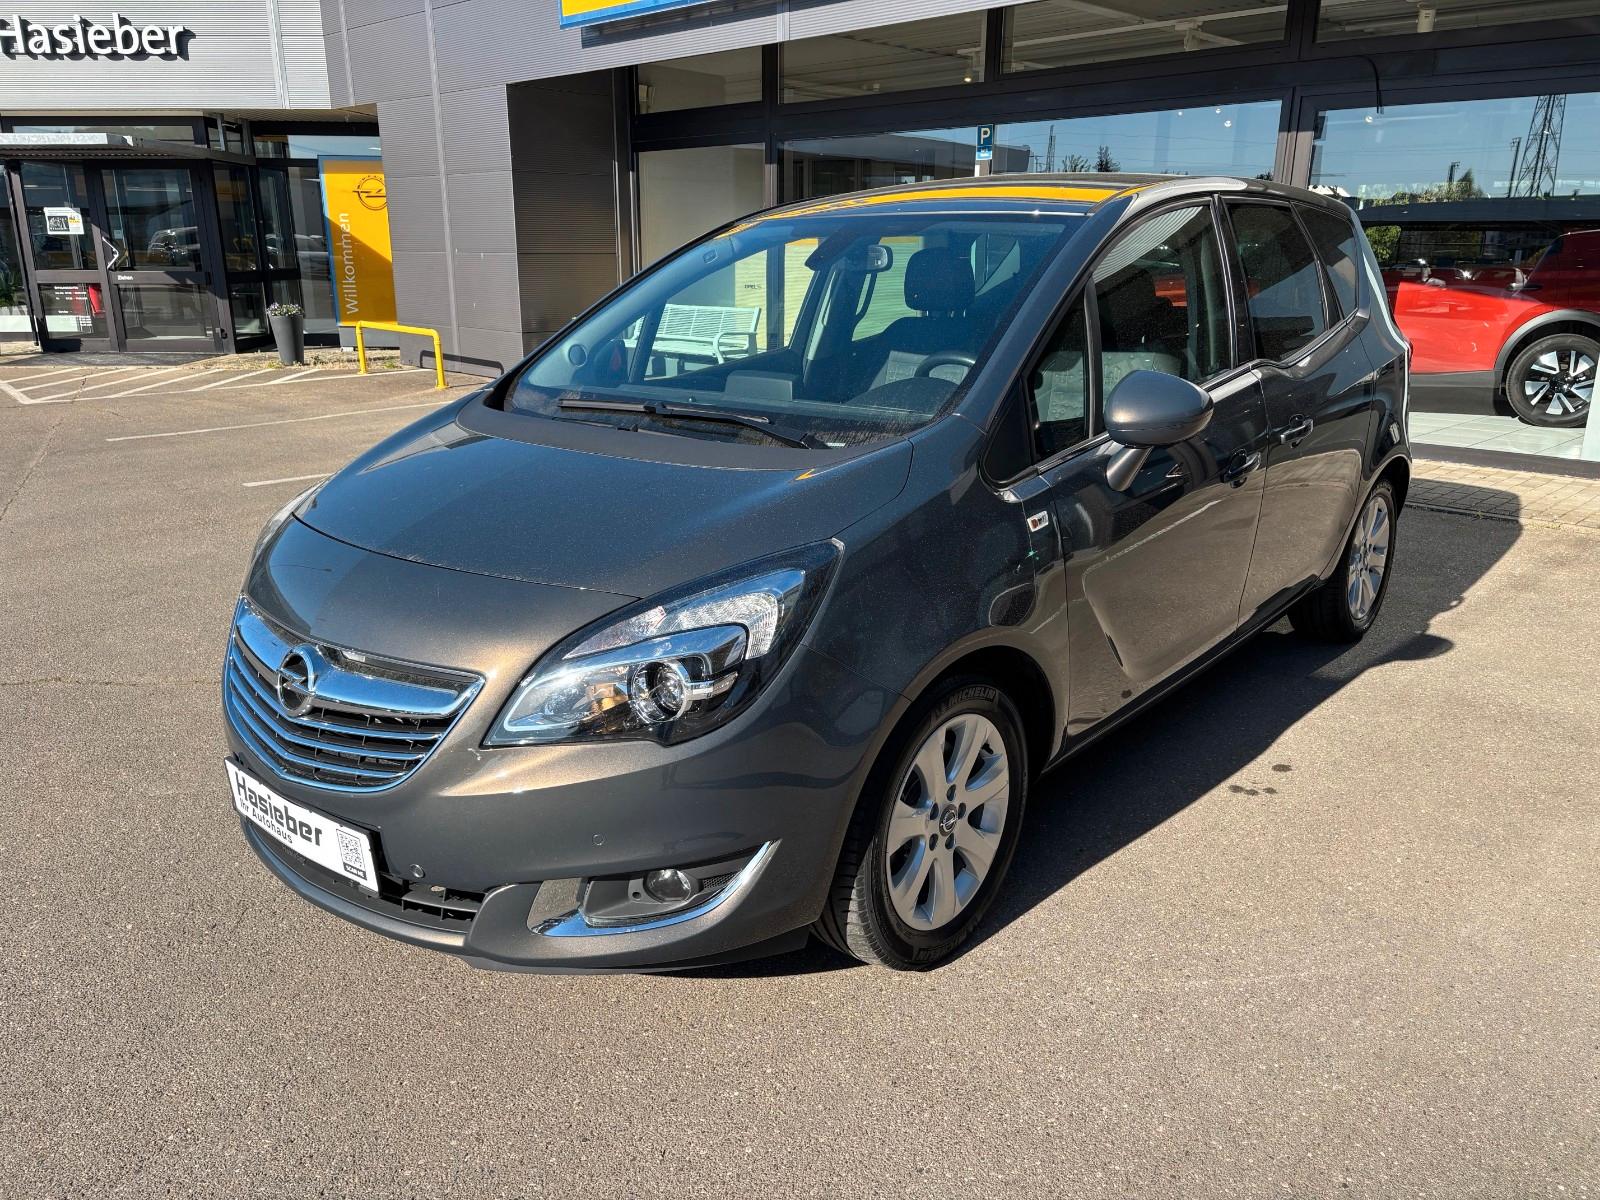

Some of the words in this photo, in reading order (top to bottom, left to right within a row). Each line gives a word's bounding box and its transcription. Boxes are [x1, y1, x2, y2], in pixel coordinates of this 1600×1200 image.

[980, 127, 991, 145] P
[338, 212, 360, 315] Willkommen
[235, 771, 323, 846] Hasieber
[239, 797, 249, 812] Ihr
[252, 807, 293, 844] Autohaus
